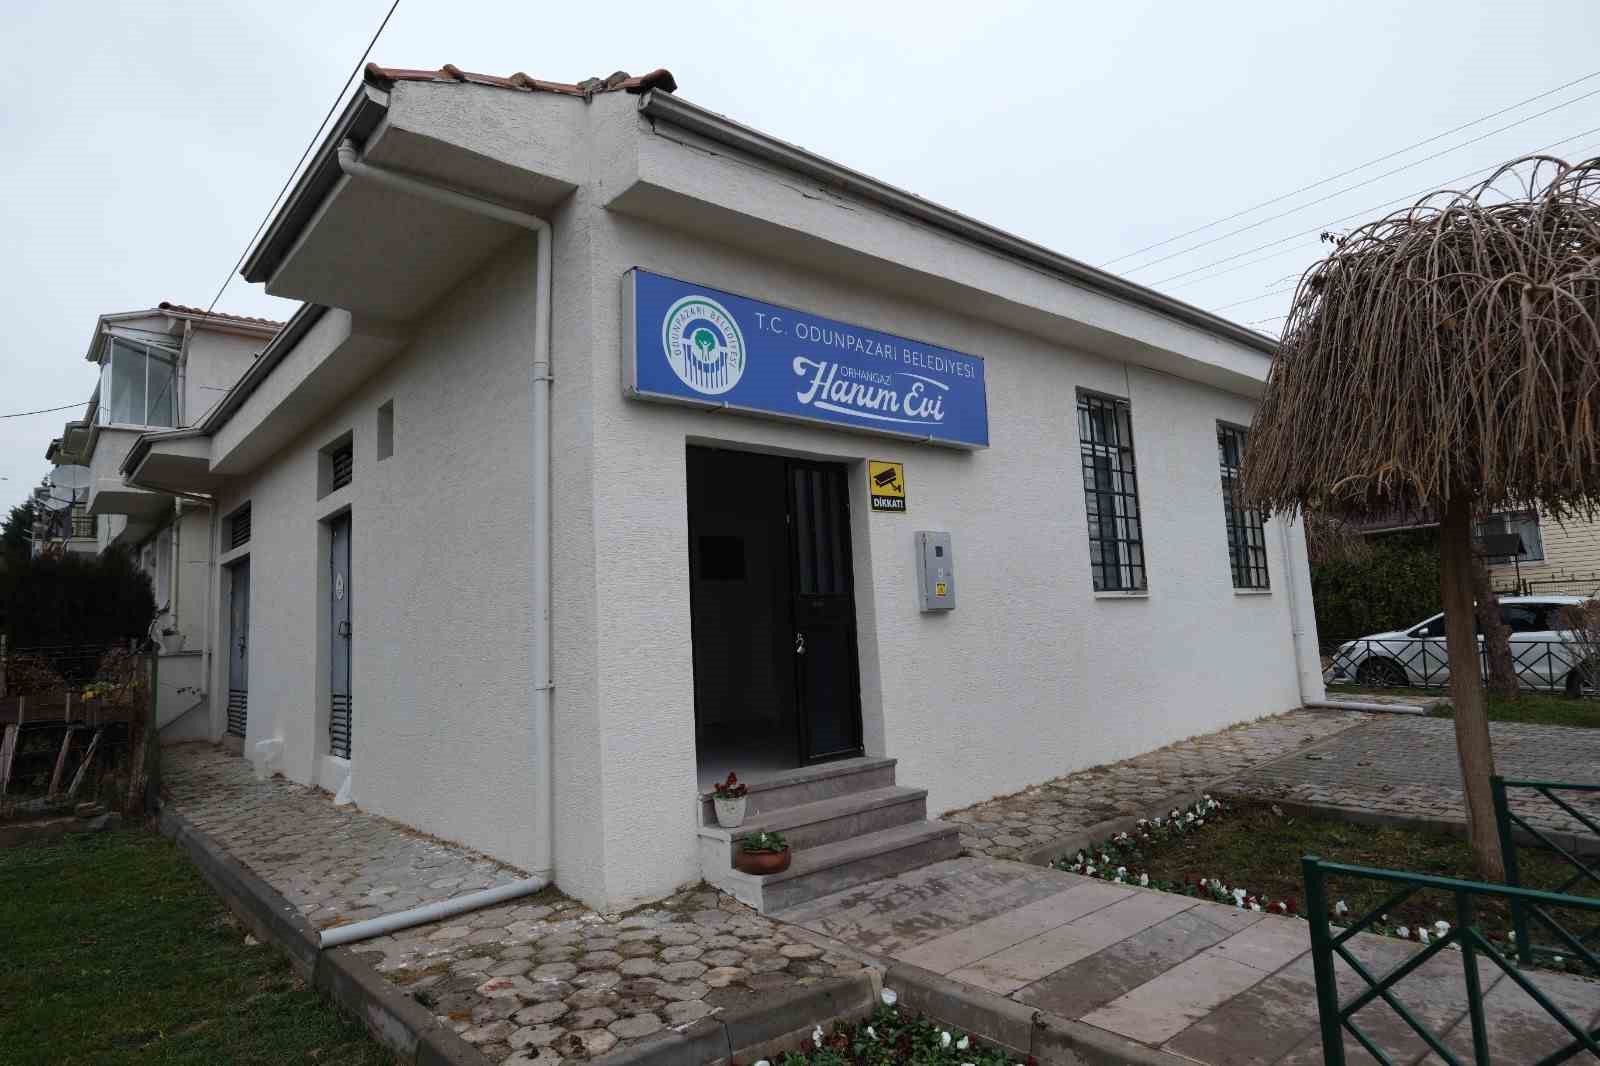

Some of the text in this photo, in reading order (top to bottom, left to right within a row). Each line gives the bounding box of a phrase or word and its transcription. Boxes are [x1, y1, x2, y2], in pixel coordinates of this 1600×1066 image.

[754, 312, 788, 336] T.C.
[795, 322, 897, 361] ODUNPAZARI
[903, 381, 945, 421] Evi
